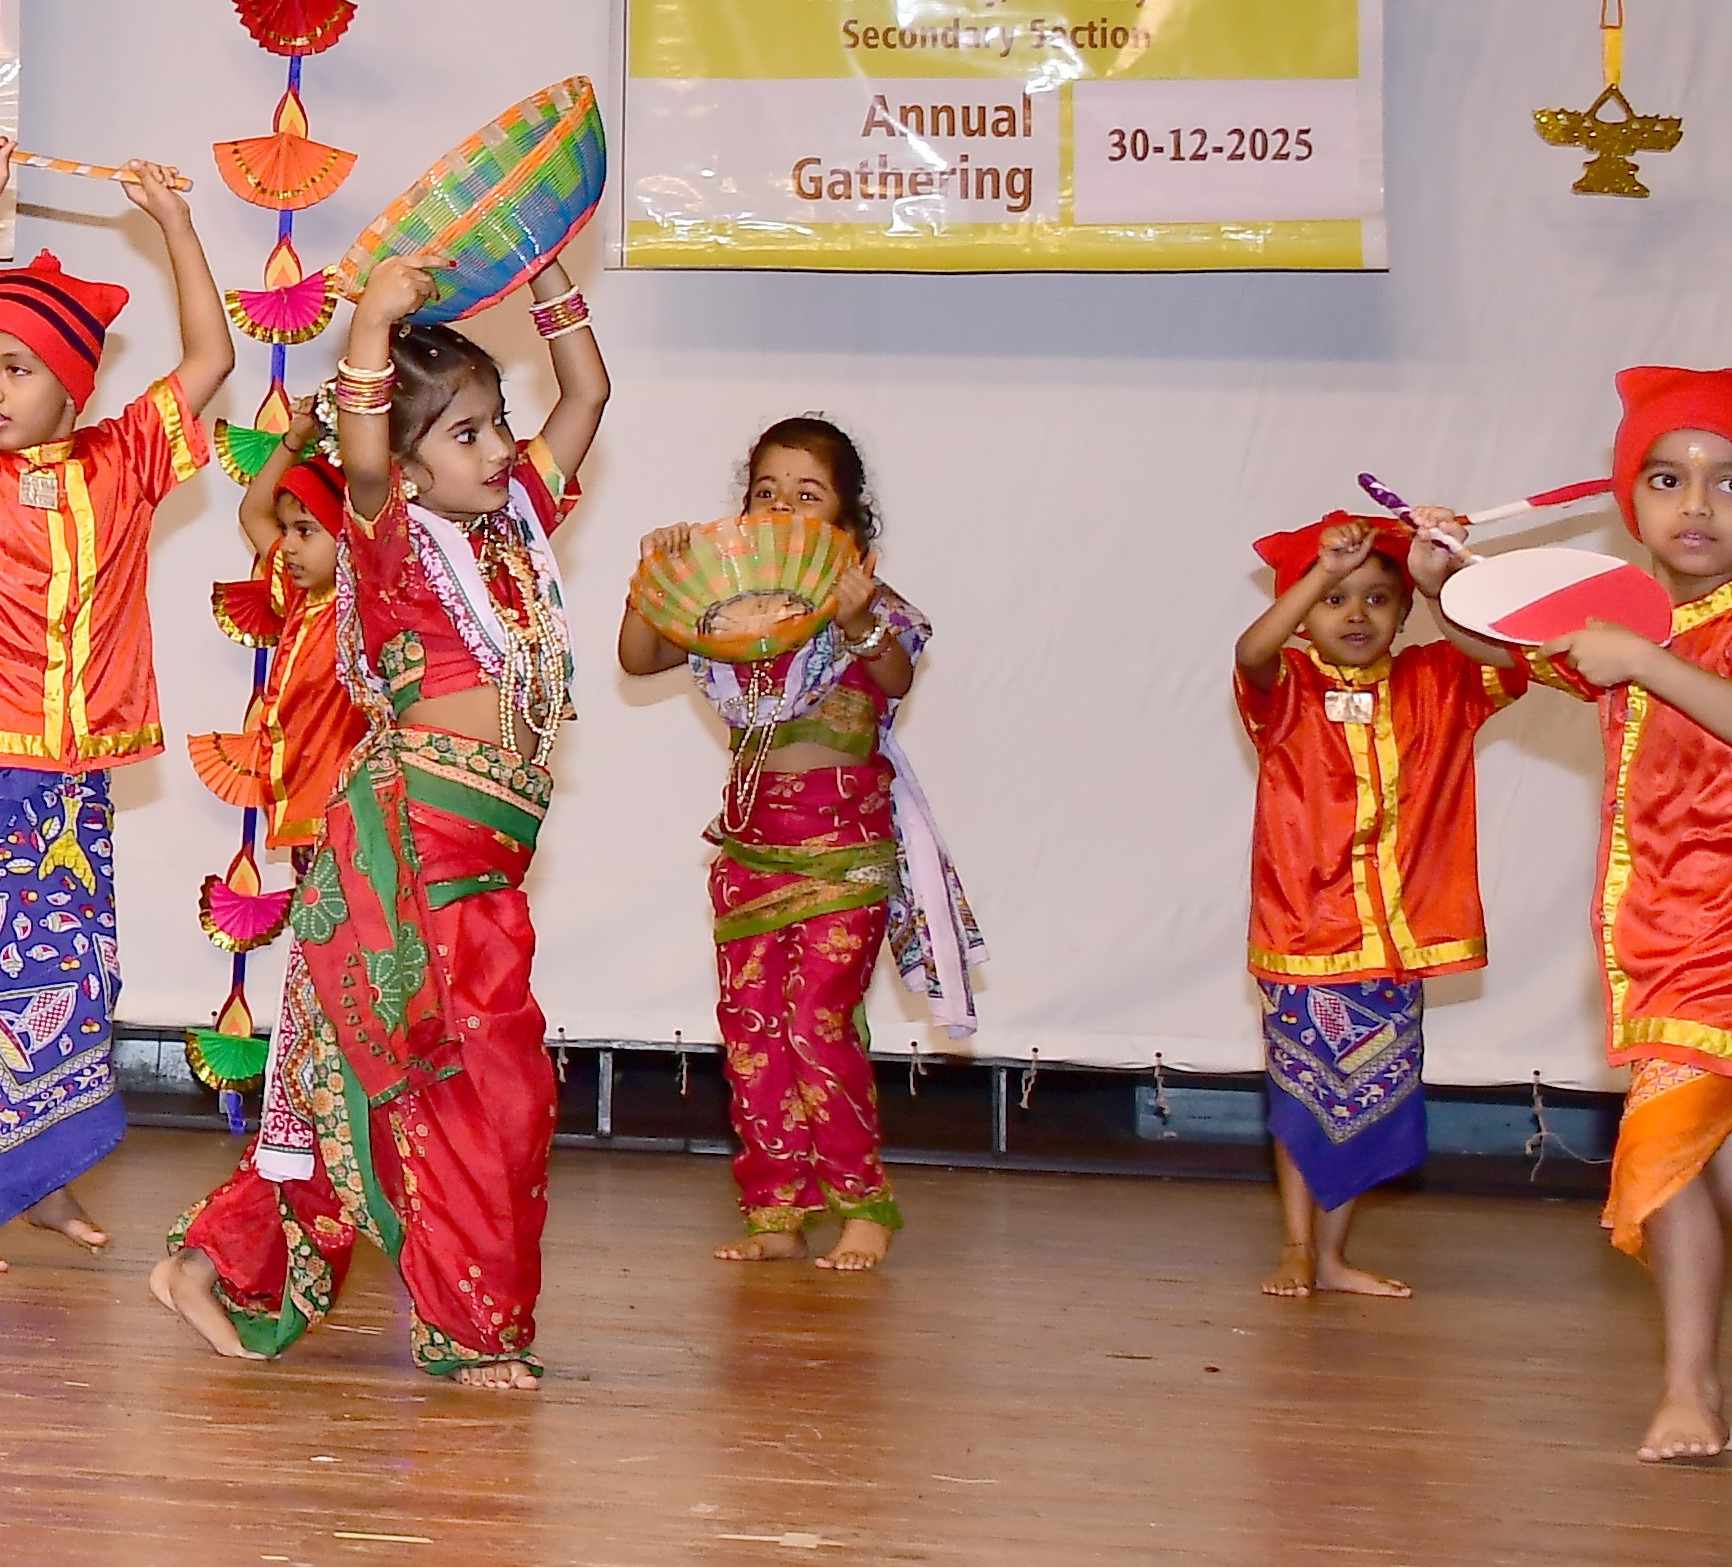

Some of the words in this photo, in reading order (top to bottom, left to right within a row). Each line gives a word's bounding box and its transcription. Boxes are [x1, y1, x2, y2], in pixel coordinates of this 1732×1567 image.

[861, 93, 1032, 138] Annual
[1107, 127, 1314, 162] 30-12-2025
[791, 153, 1033, 214] Gathering
